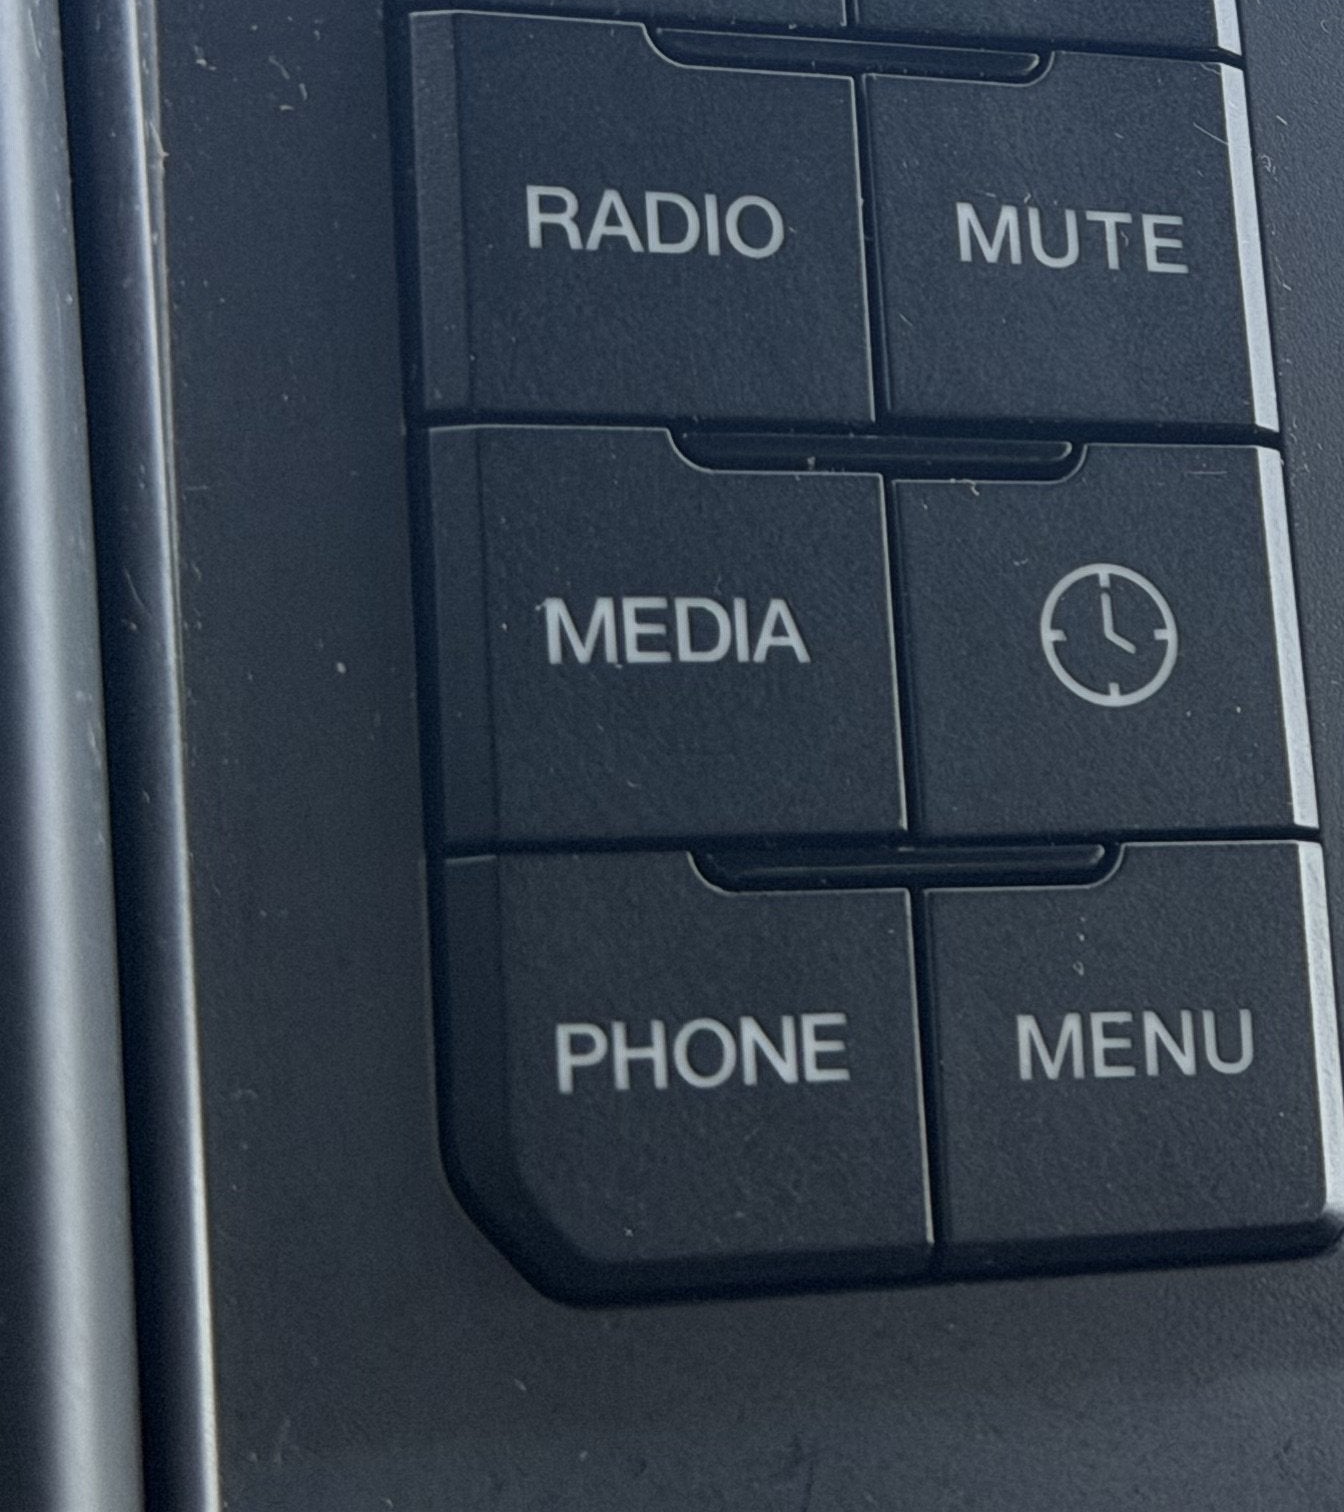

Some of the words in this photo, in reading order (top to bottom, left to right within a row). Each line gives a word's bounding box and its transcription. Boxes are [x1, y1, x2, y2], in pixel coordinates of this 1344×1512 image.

[525, 184, 785, 260] RADIO
[955, 202, 1189, 276] MUTE
[542, 597, 811, 665] MEDIA
[554, 1011, 850, 1094] PHONE
[1017, 1009, 1254, 1082] MENU
